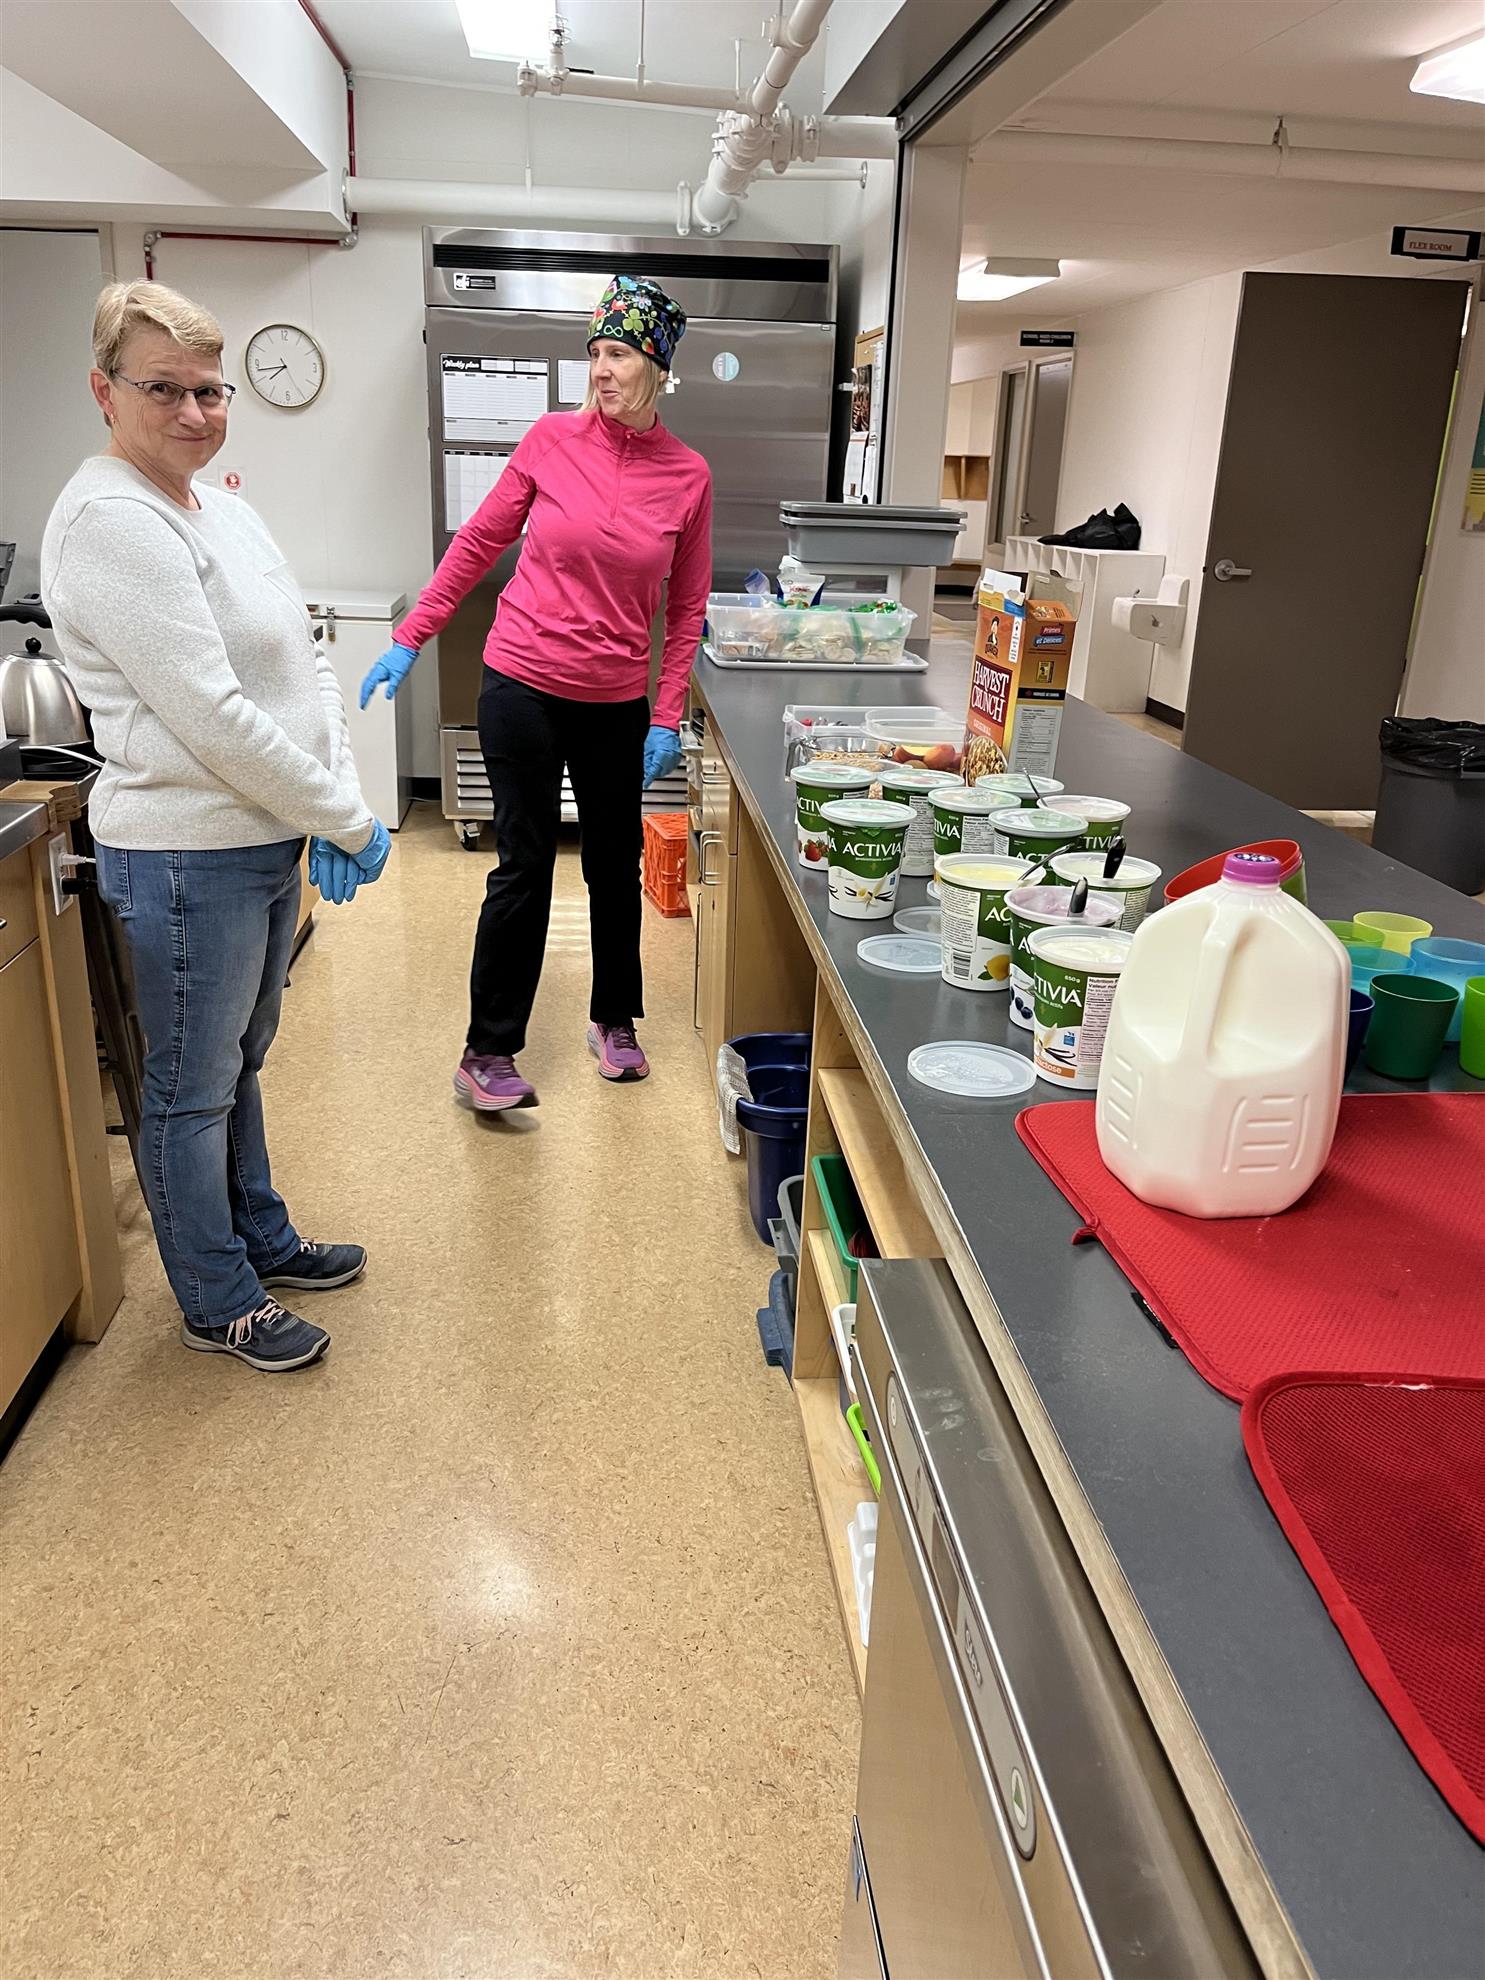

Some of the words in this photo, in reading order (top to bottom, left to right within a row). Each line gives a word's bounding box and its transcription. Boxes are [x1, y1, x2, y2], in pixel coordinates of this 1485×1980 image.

[1429, 242, 1453, 252] ROOM
[281, 330, 289, 341] 12
[255, 358, 260, 369] 9
[313, 362, 318, 373] 3
[465, 361, 480, 370] plan
[285, 391, 291, 402] 6
[973, 661, 1009, 698] HARVEST
[971, 685, 1007, 723] CRUNCH
[934, 818, 961, 839] TIVIA
[842, 840, 903, 857] ACTIVIA
[1034, 972, 1083, 1008] TIVIA
